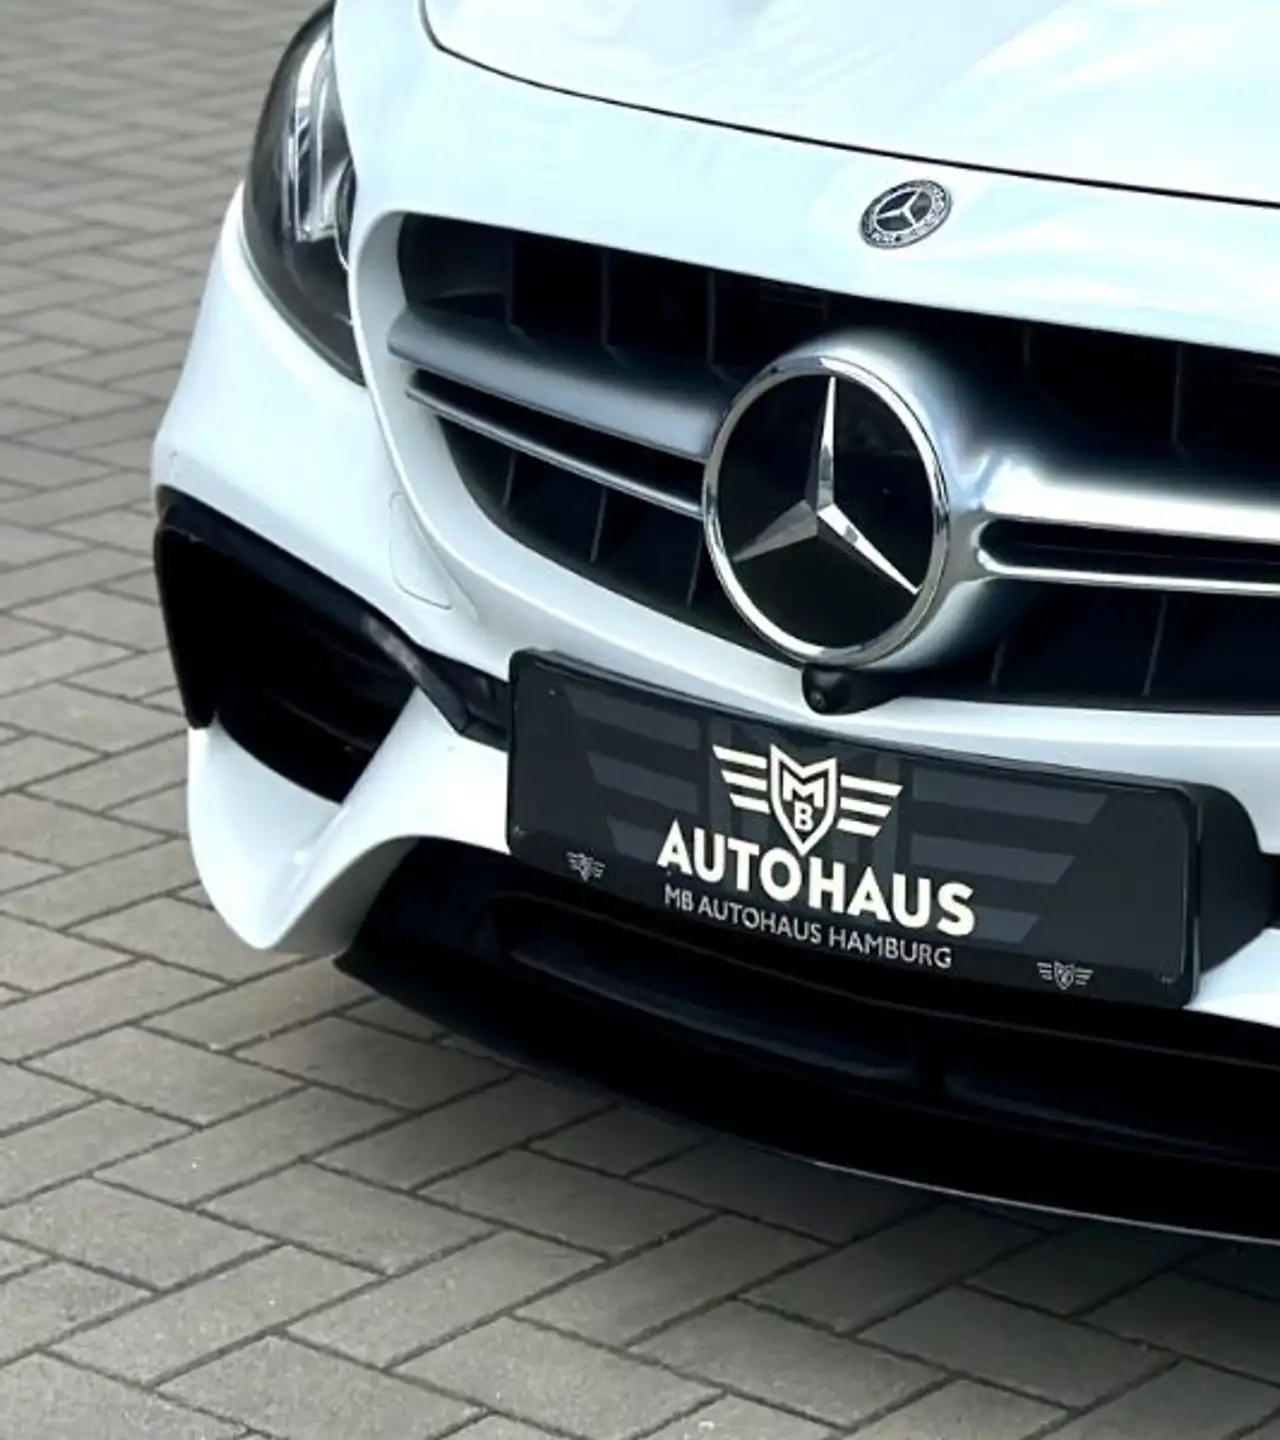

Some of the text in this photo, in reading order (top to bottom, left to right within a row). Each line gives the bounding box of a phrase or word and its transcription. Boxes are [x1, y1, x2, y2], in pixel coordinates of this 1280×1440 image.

[657, 819, 976, 937] AUTOHAUS
[664, 882, 953, 970] MB AUTOHAUS HAMBURG
